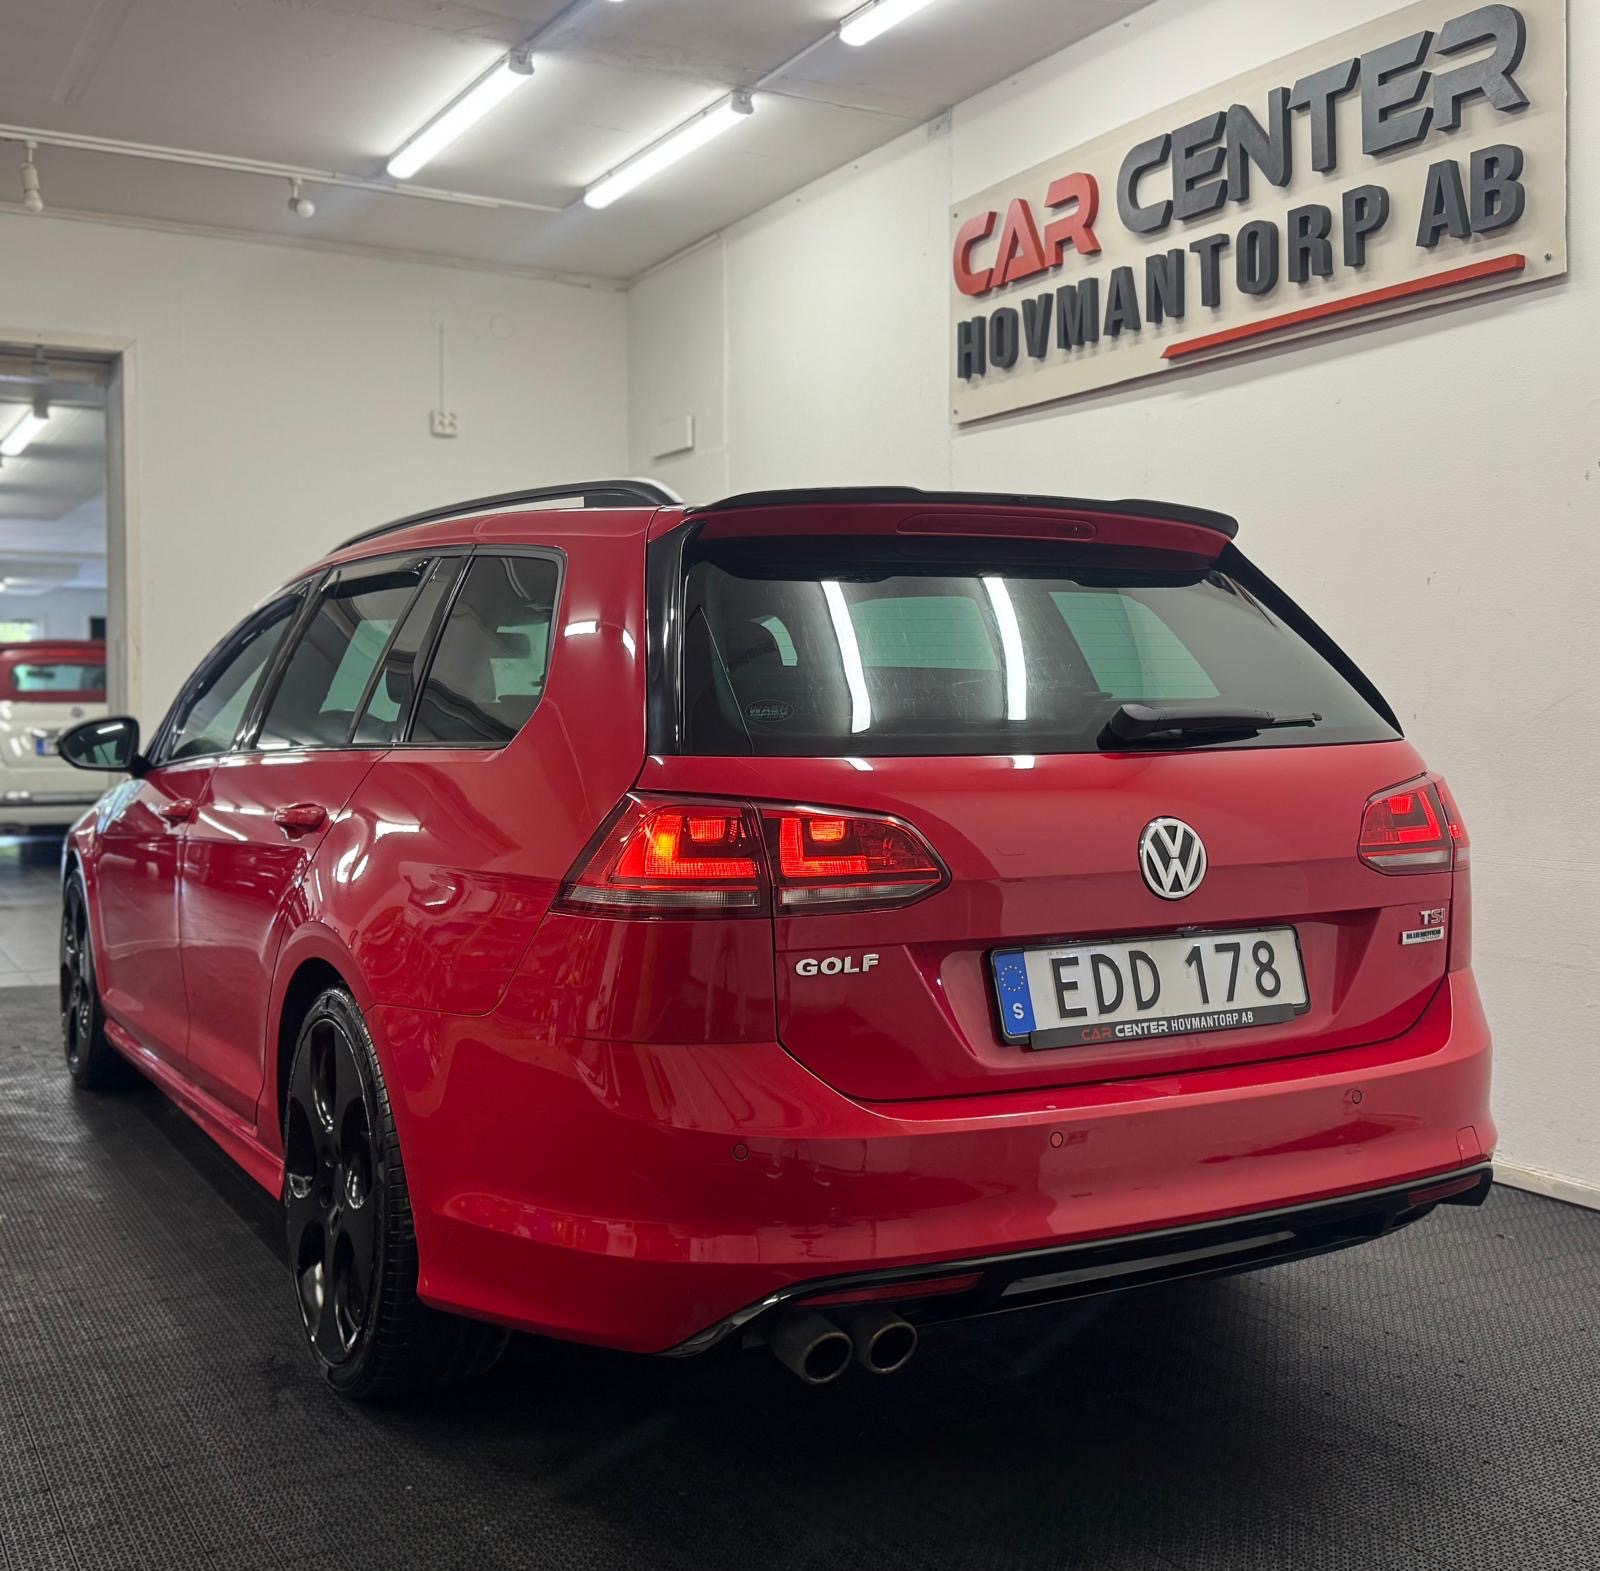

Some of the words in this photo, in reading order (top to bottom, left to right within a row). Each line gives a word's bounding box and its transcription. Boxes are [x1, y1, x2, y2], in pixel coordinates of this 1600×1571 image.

[952, 171, 1102, 297] CAR
[1117, 3, 1530, 235] CENTER
[957, 184, 1390, 380] HOVMANTORP
[1416, 143, 1526, 249] AB
[795, 954, 879, 976] GOLF
[1051, 950, 1161, 1019] EDD
[1185, 940, 1281, 1005] 178
[1012, 1002, 1025, 1020] S
[1081, 1027, 1113, 1041] CAR
[1115, 1020, 1168, 1037] CENTER
[1171, 1012, 1239, 1032] HOVMANTORP
[1242, 1011, 1254, 1024] AB
